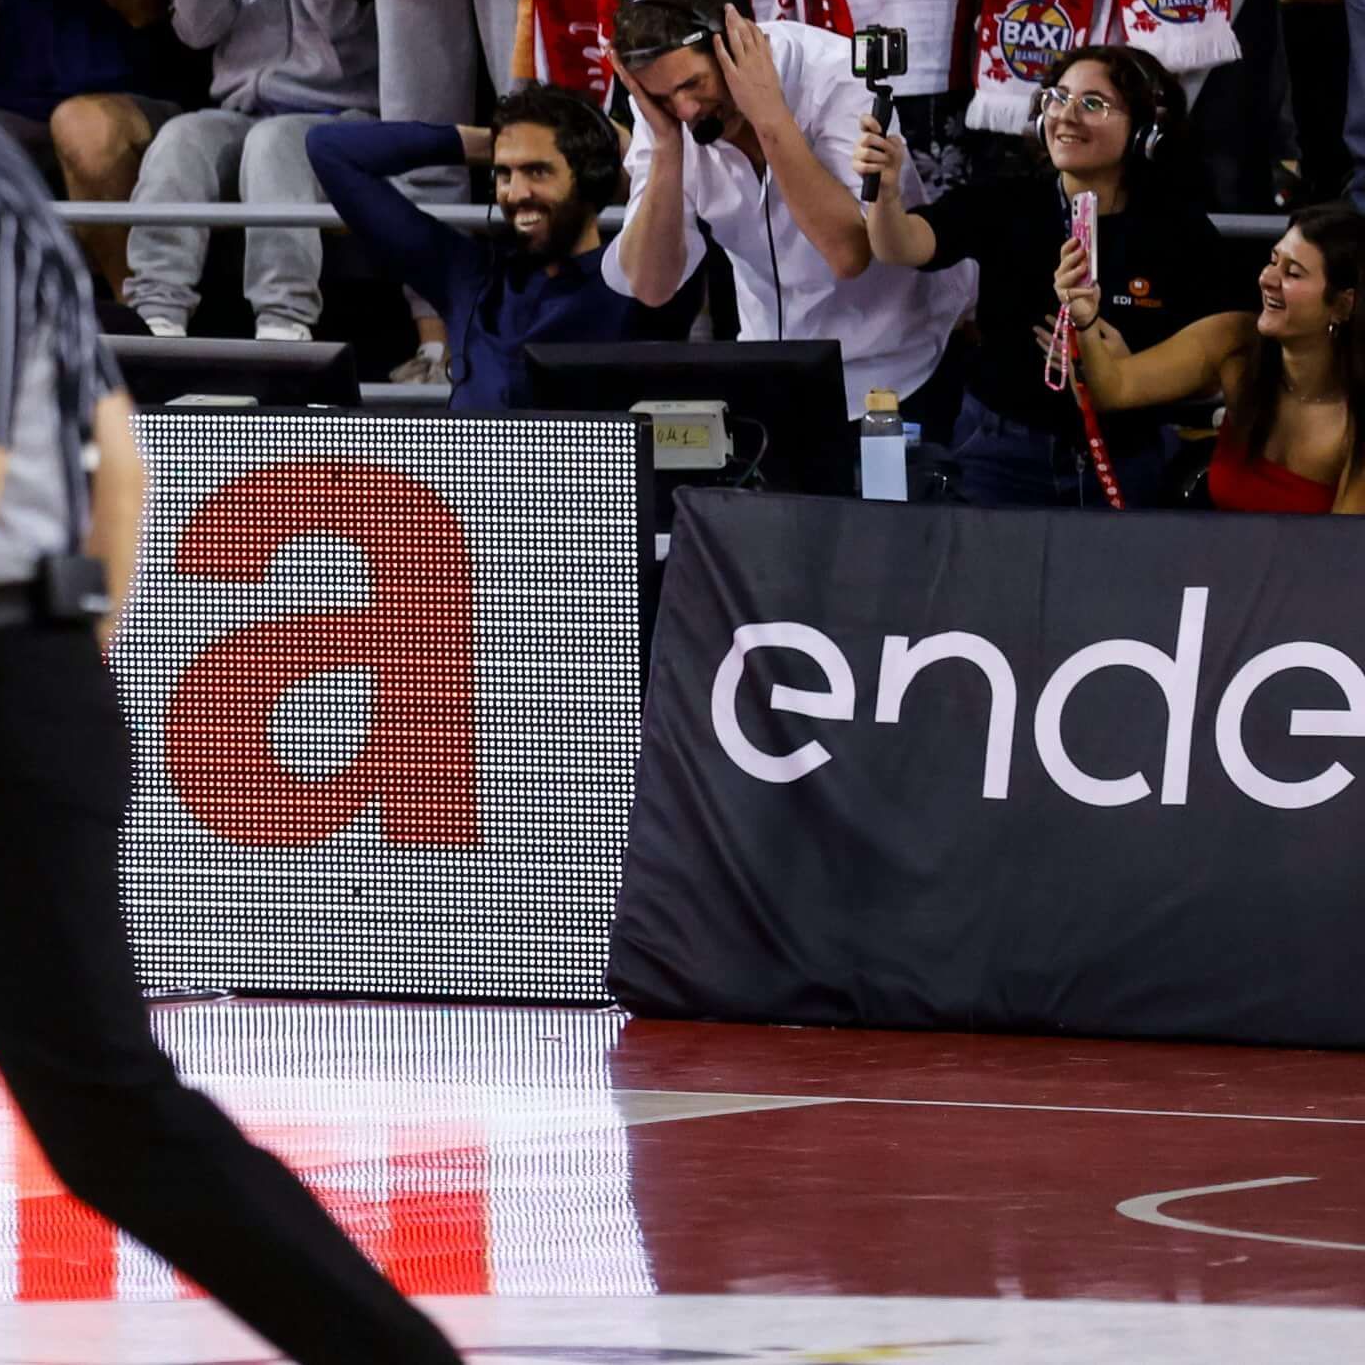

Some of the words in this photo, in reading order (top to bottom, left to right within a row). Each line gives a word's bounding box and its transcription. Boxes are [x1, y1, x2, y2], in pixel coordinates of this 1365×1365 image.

[1003, 20, 1070, 52] BAXI
[1112, 295, 1132, 306] EDI
[711, 585, 1365, 811] ende
